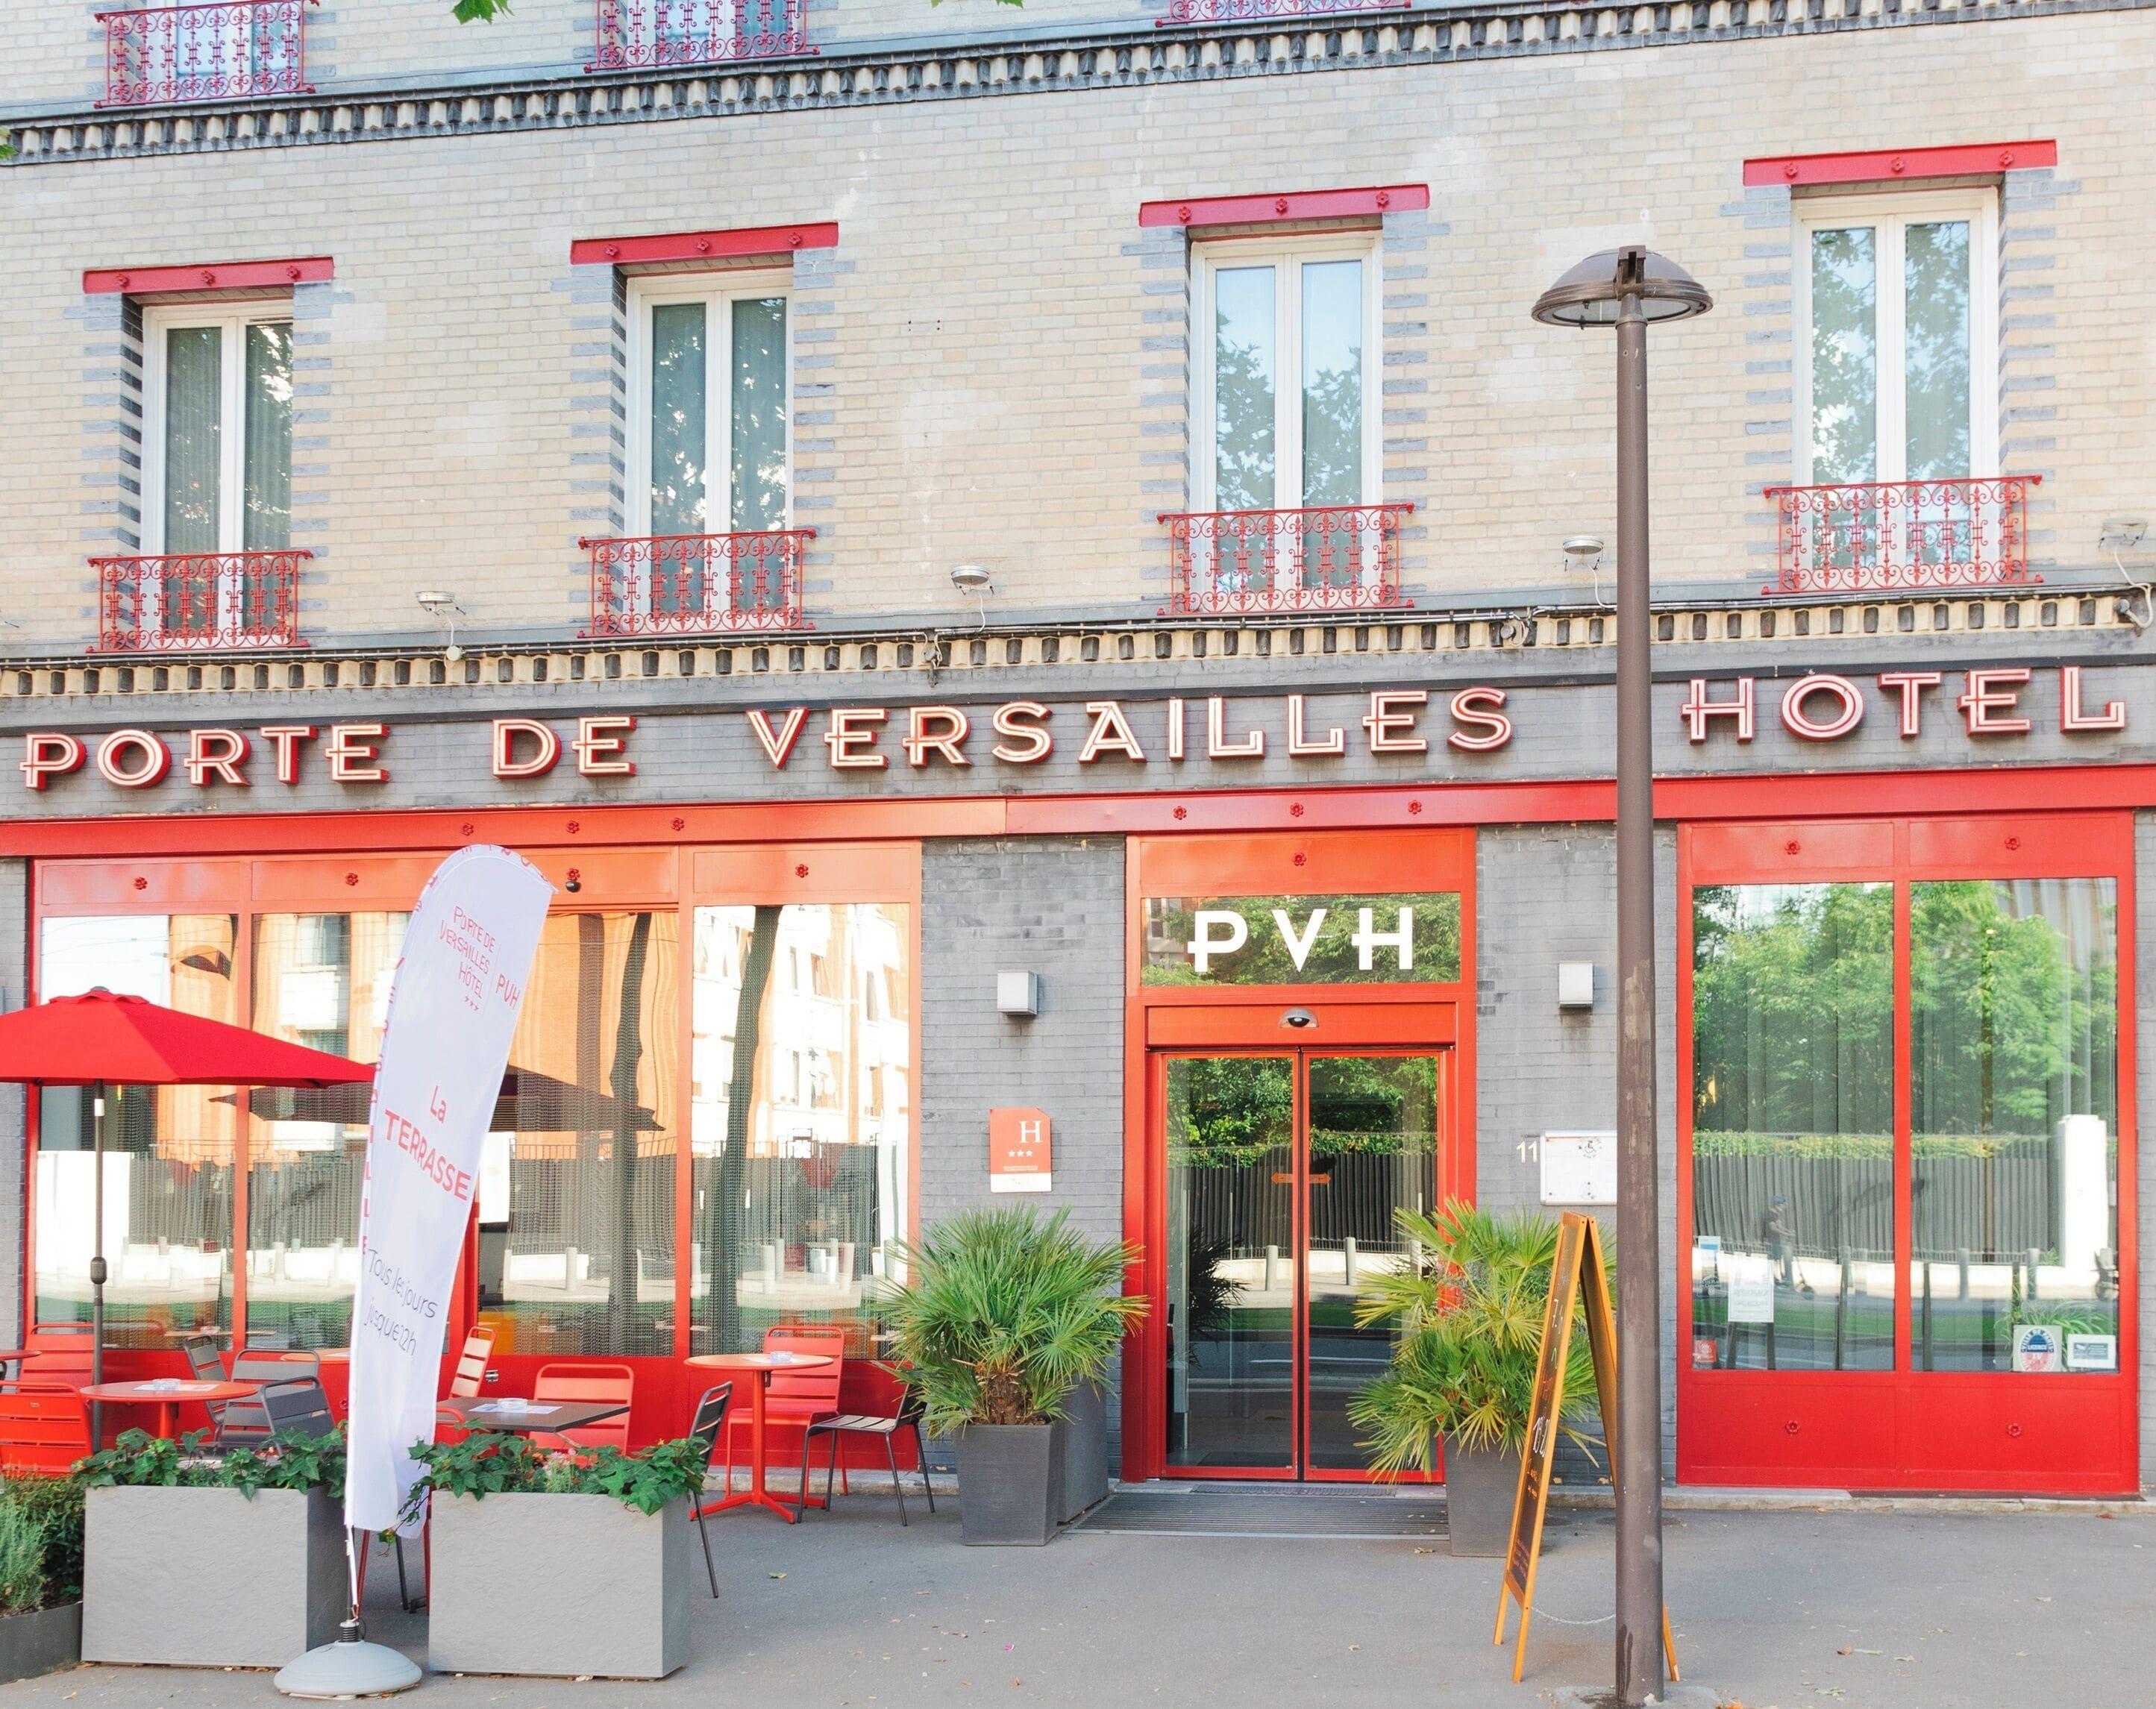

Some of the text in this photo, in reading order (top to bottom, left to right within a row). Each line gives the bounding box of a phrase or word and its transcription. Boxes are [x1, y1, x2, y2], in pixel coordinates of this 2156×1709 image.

[19, 665, 2126, 791] PORTE DE VERSAILLES HOTEL
[439, 919, 491, 975] VERSAILLES
[454, 906, 496, 953] PORTE DE
[1187, 906, 1414, 973] PVH
[430, 1085, 447, 1123] La
[385, 1109, 472, 1201] TERRASSE
[1019, 1120, 1043, 1144] H
[1516, 1140, 1538, 1163] 11
[401, 1279, 439, 1318] jours
